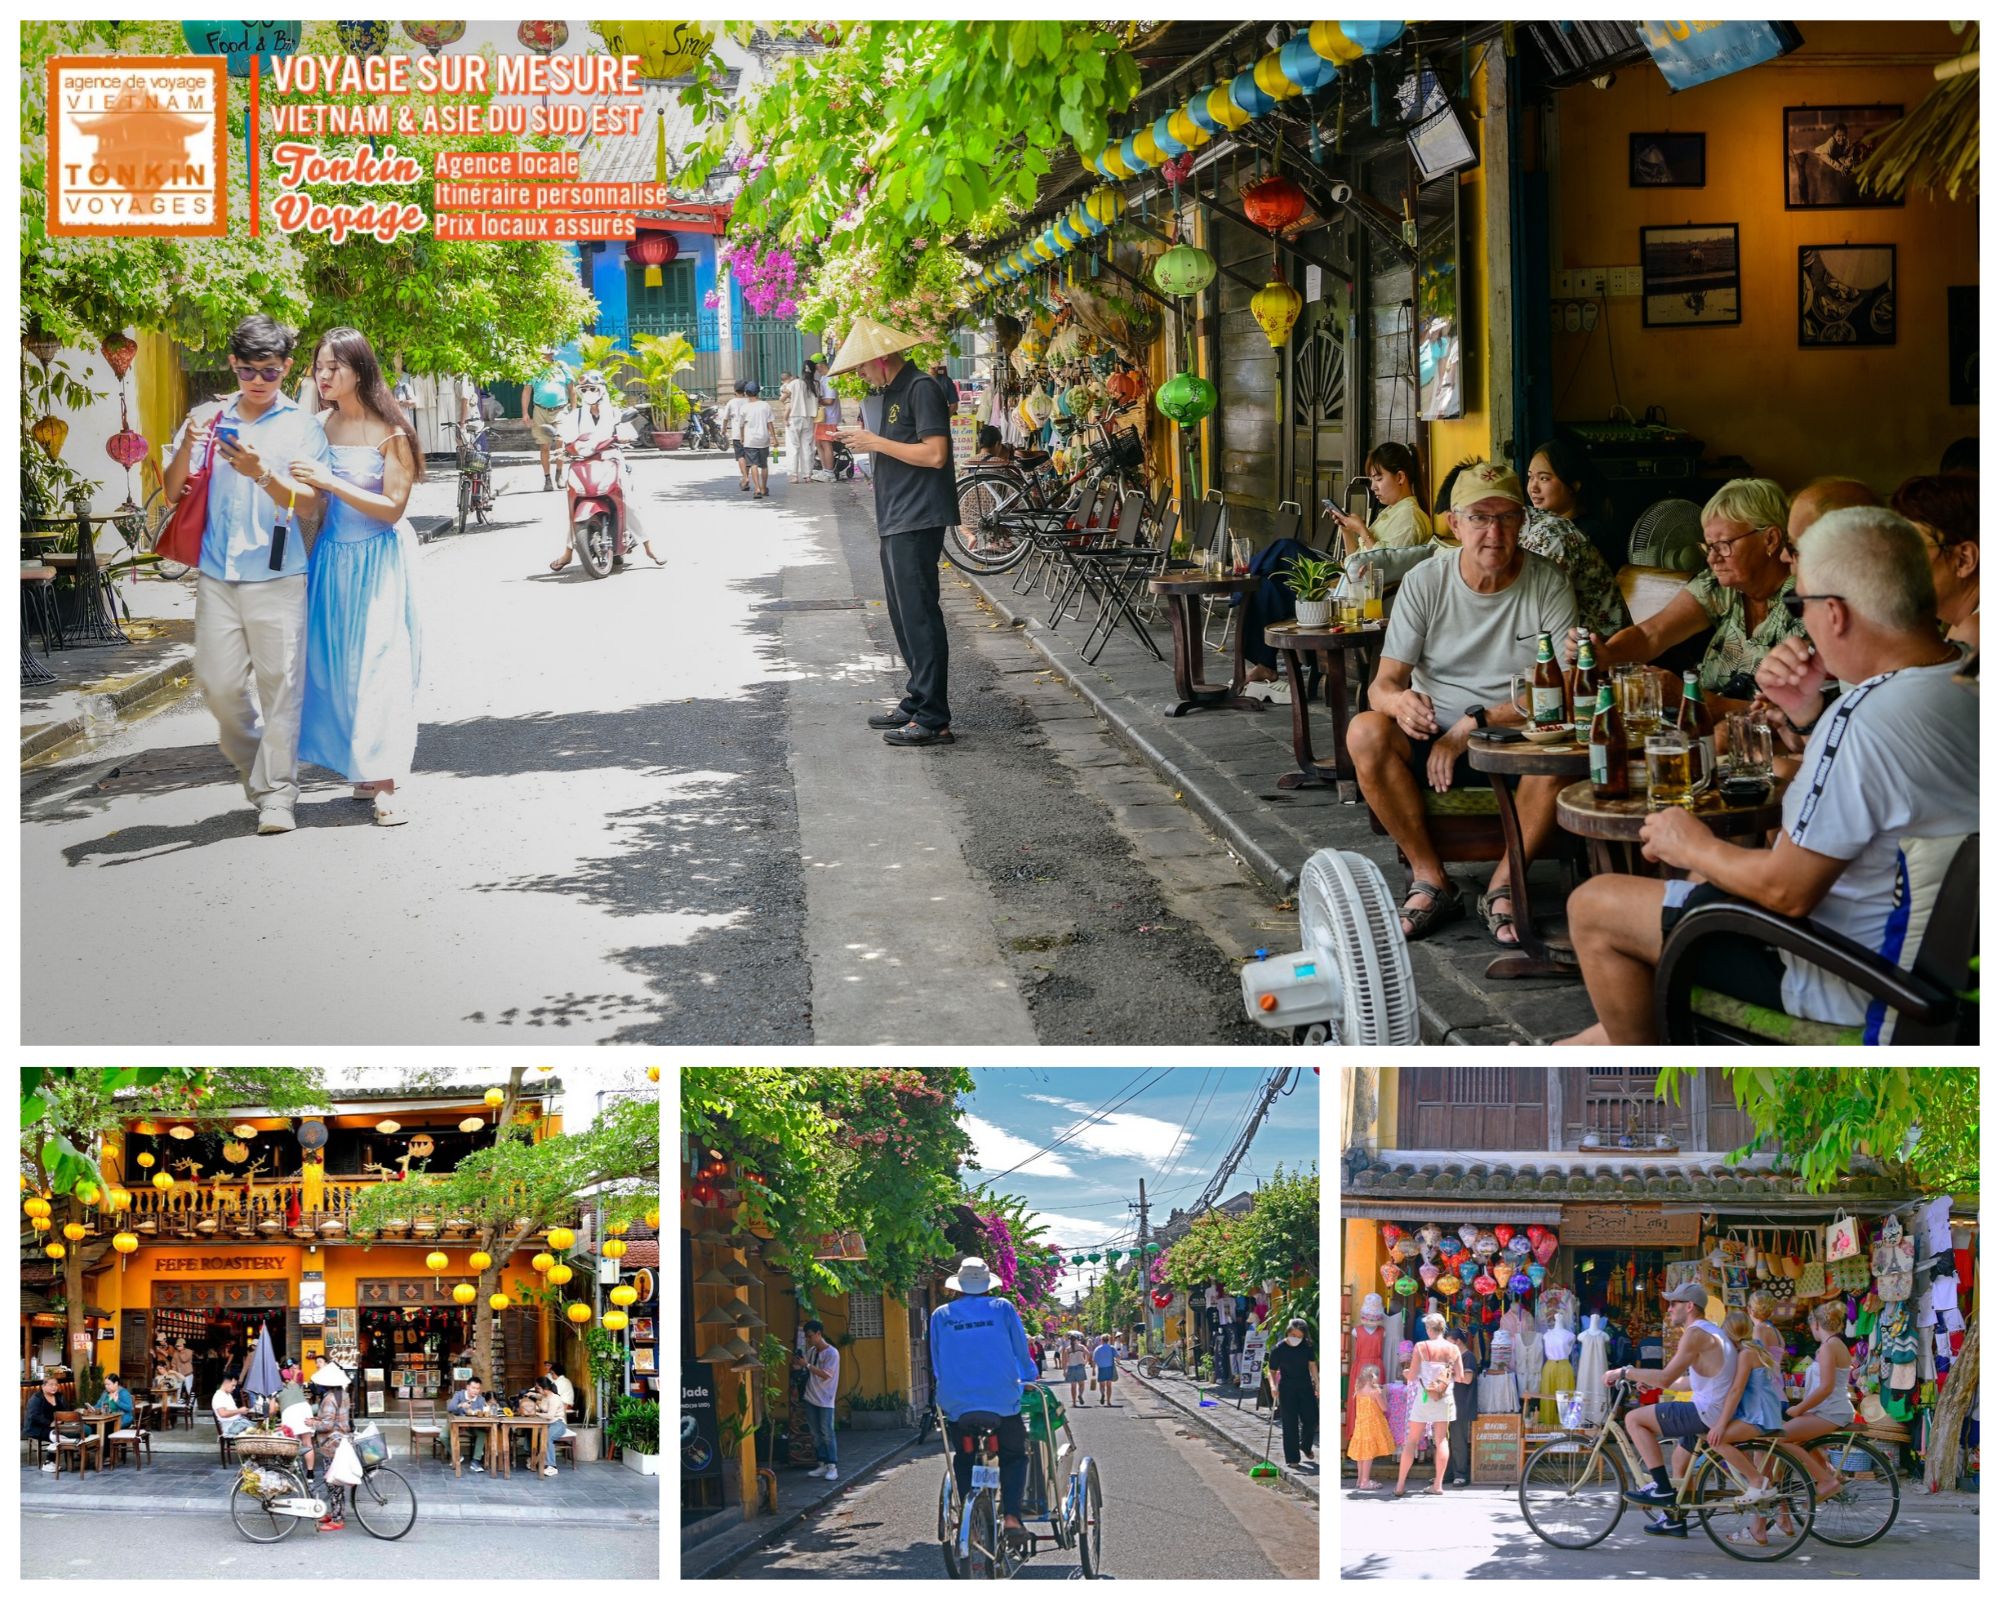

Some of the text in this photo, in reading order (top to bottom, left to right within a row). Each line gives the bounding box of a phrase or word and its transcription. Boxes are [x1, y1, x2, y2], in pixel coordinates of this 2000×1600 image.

[206, 29, 250, 54] Food
[154, 1256, 287, 1272] FEFE ROASTERY
[682, 1386, 709, 1399] Jade
